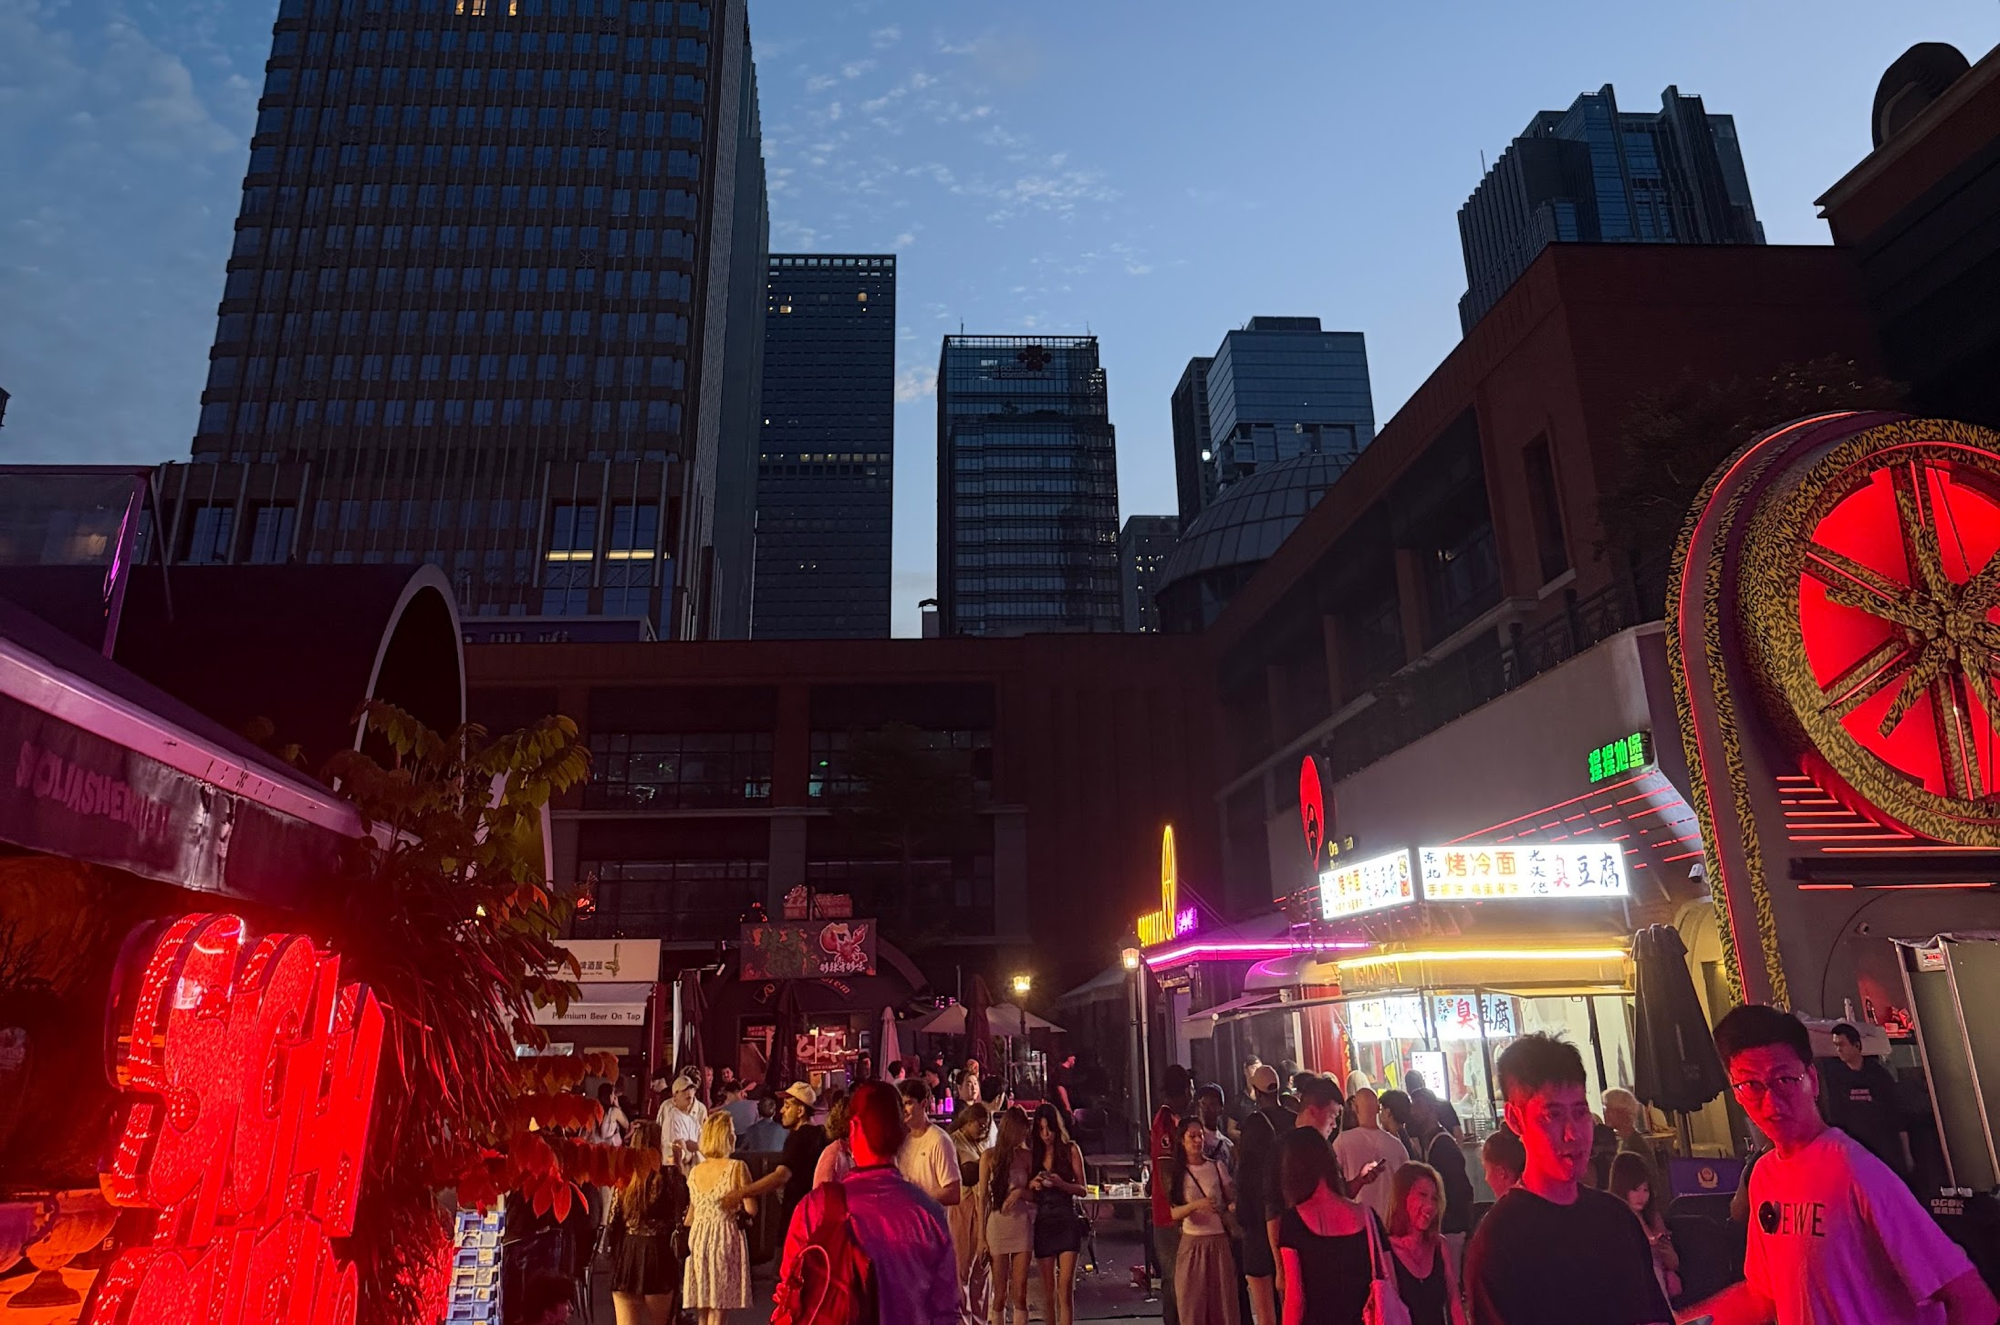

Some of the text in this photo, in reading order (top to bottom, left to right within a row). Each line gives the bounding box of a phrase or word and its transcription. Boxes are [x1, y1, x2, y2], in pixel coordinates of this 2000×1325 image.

[1588, 732, 1645, 783] 猩猩地堡
[1424, 853, 1441, 879] 东北
[1445, 851, 1516, 877] 烤冷面
[1553, 852, 1620, 888] 臭豆腐
[552, 1011, 640, 1021] Pmium Beer On Tap
